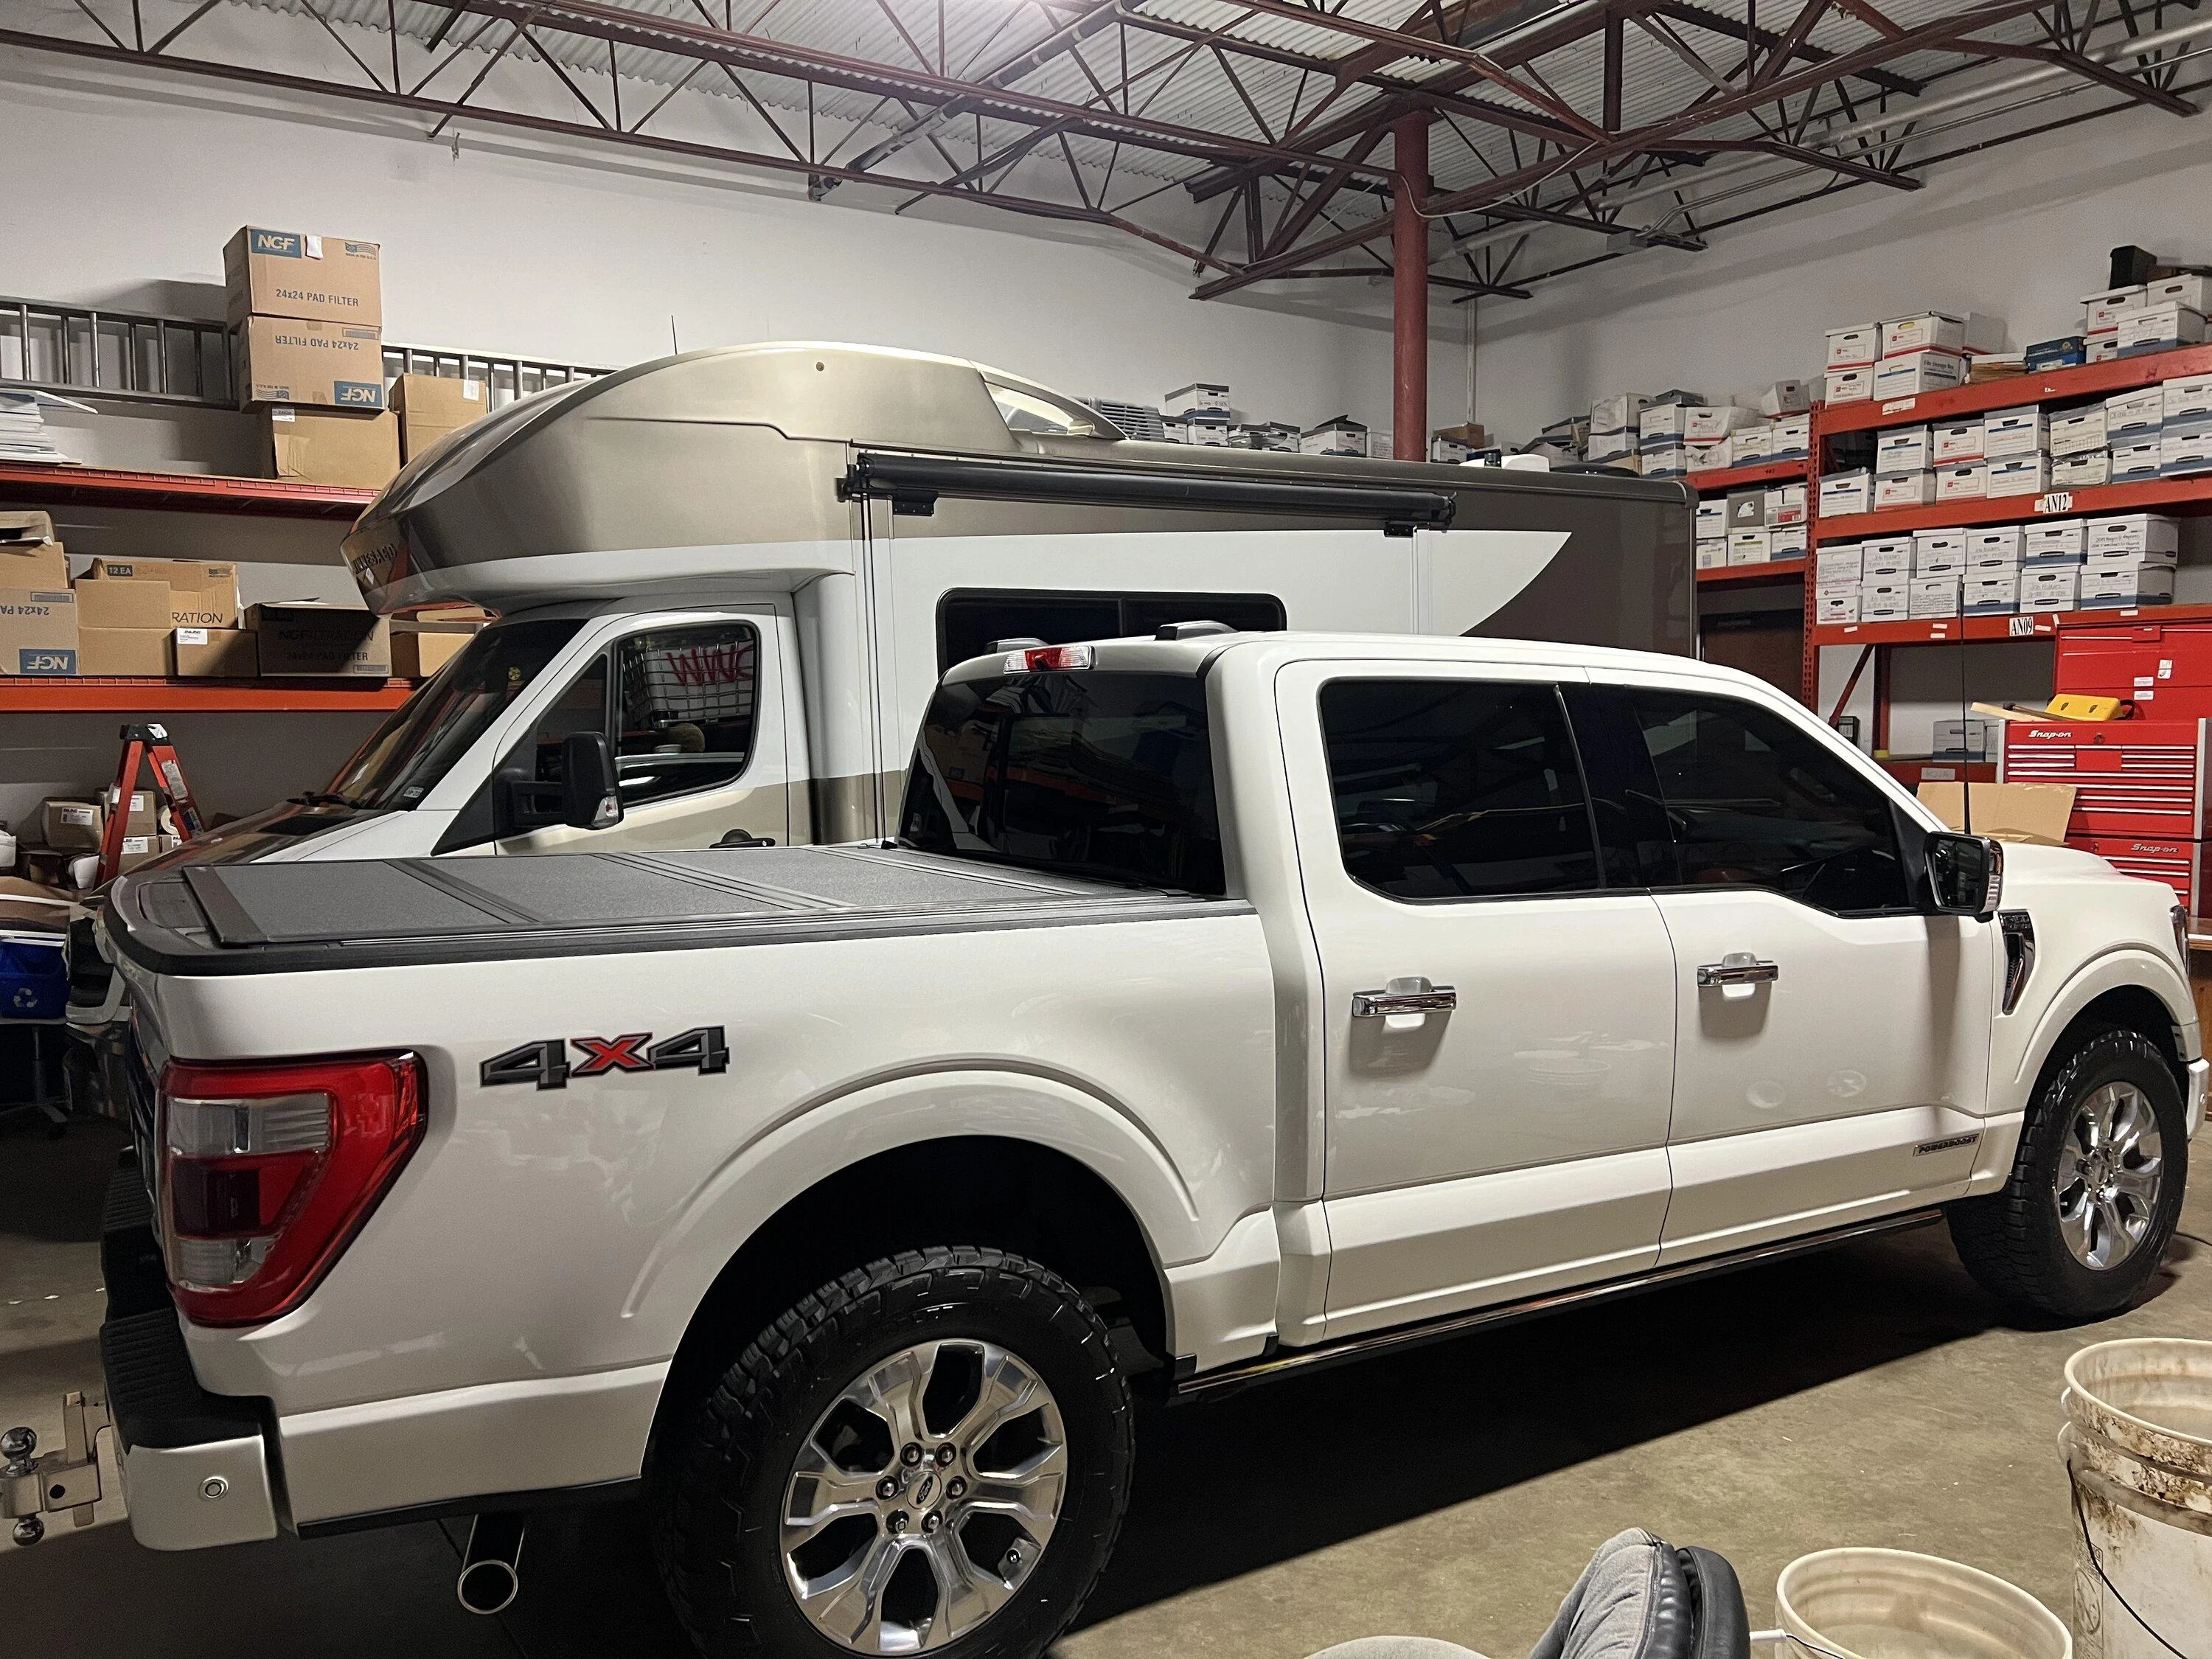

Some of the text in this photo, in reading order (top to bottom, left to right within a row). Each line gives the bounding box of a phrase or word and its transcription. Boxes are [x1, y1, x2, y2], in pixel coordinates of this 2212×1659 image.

[258, 234, 295, 251] NCF
[276, 288, 358, 307] 24x24 PAD FILTER
[275, 335, 359, 351] 24x24 PAD FILTER
[341, 389, 376, 403] NCF
[2045, 493, 2067, 512] AN12
[18, 605, 49, 616] 24x24
[172, 611, 223, 625] RATION
[2011, 616, 2033, 636] AN09
[27, 655, 69, 670] NCF
[2028, 729, 2073, 740] Snap-on
[2130, 843, 2180, 854] Snap-on
